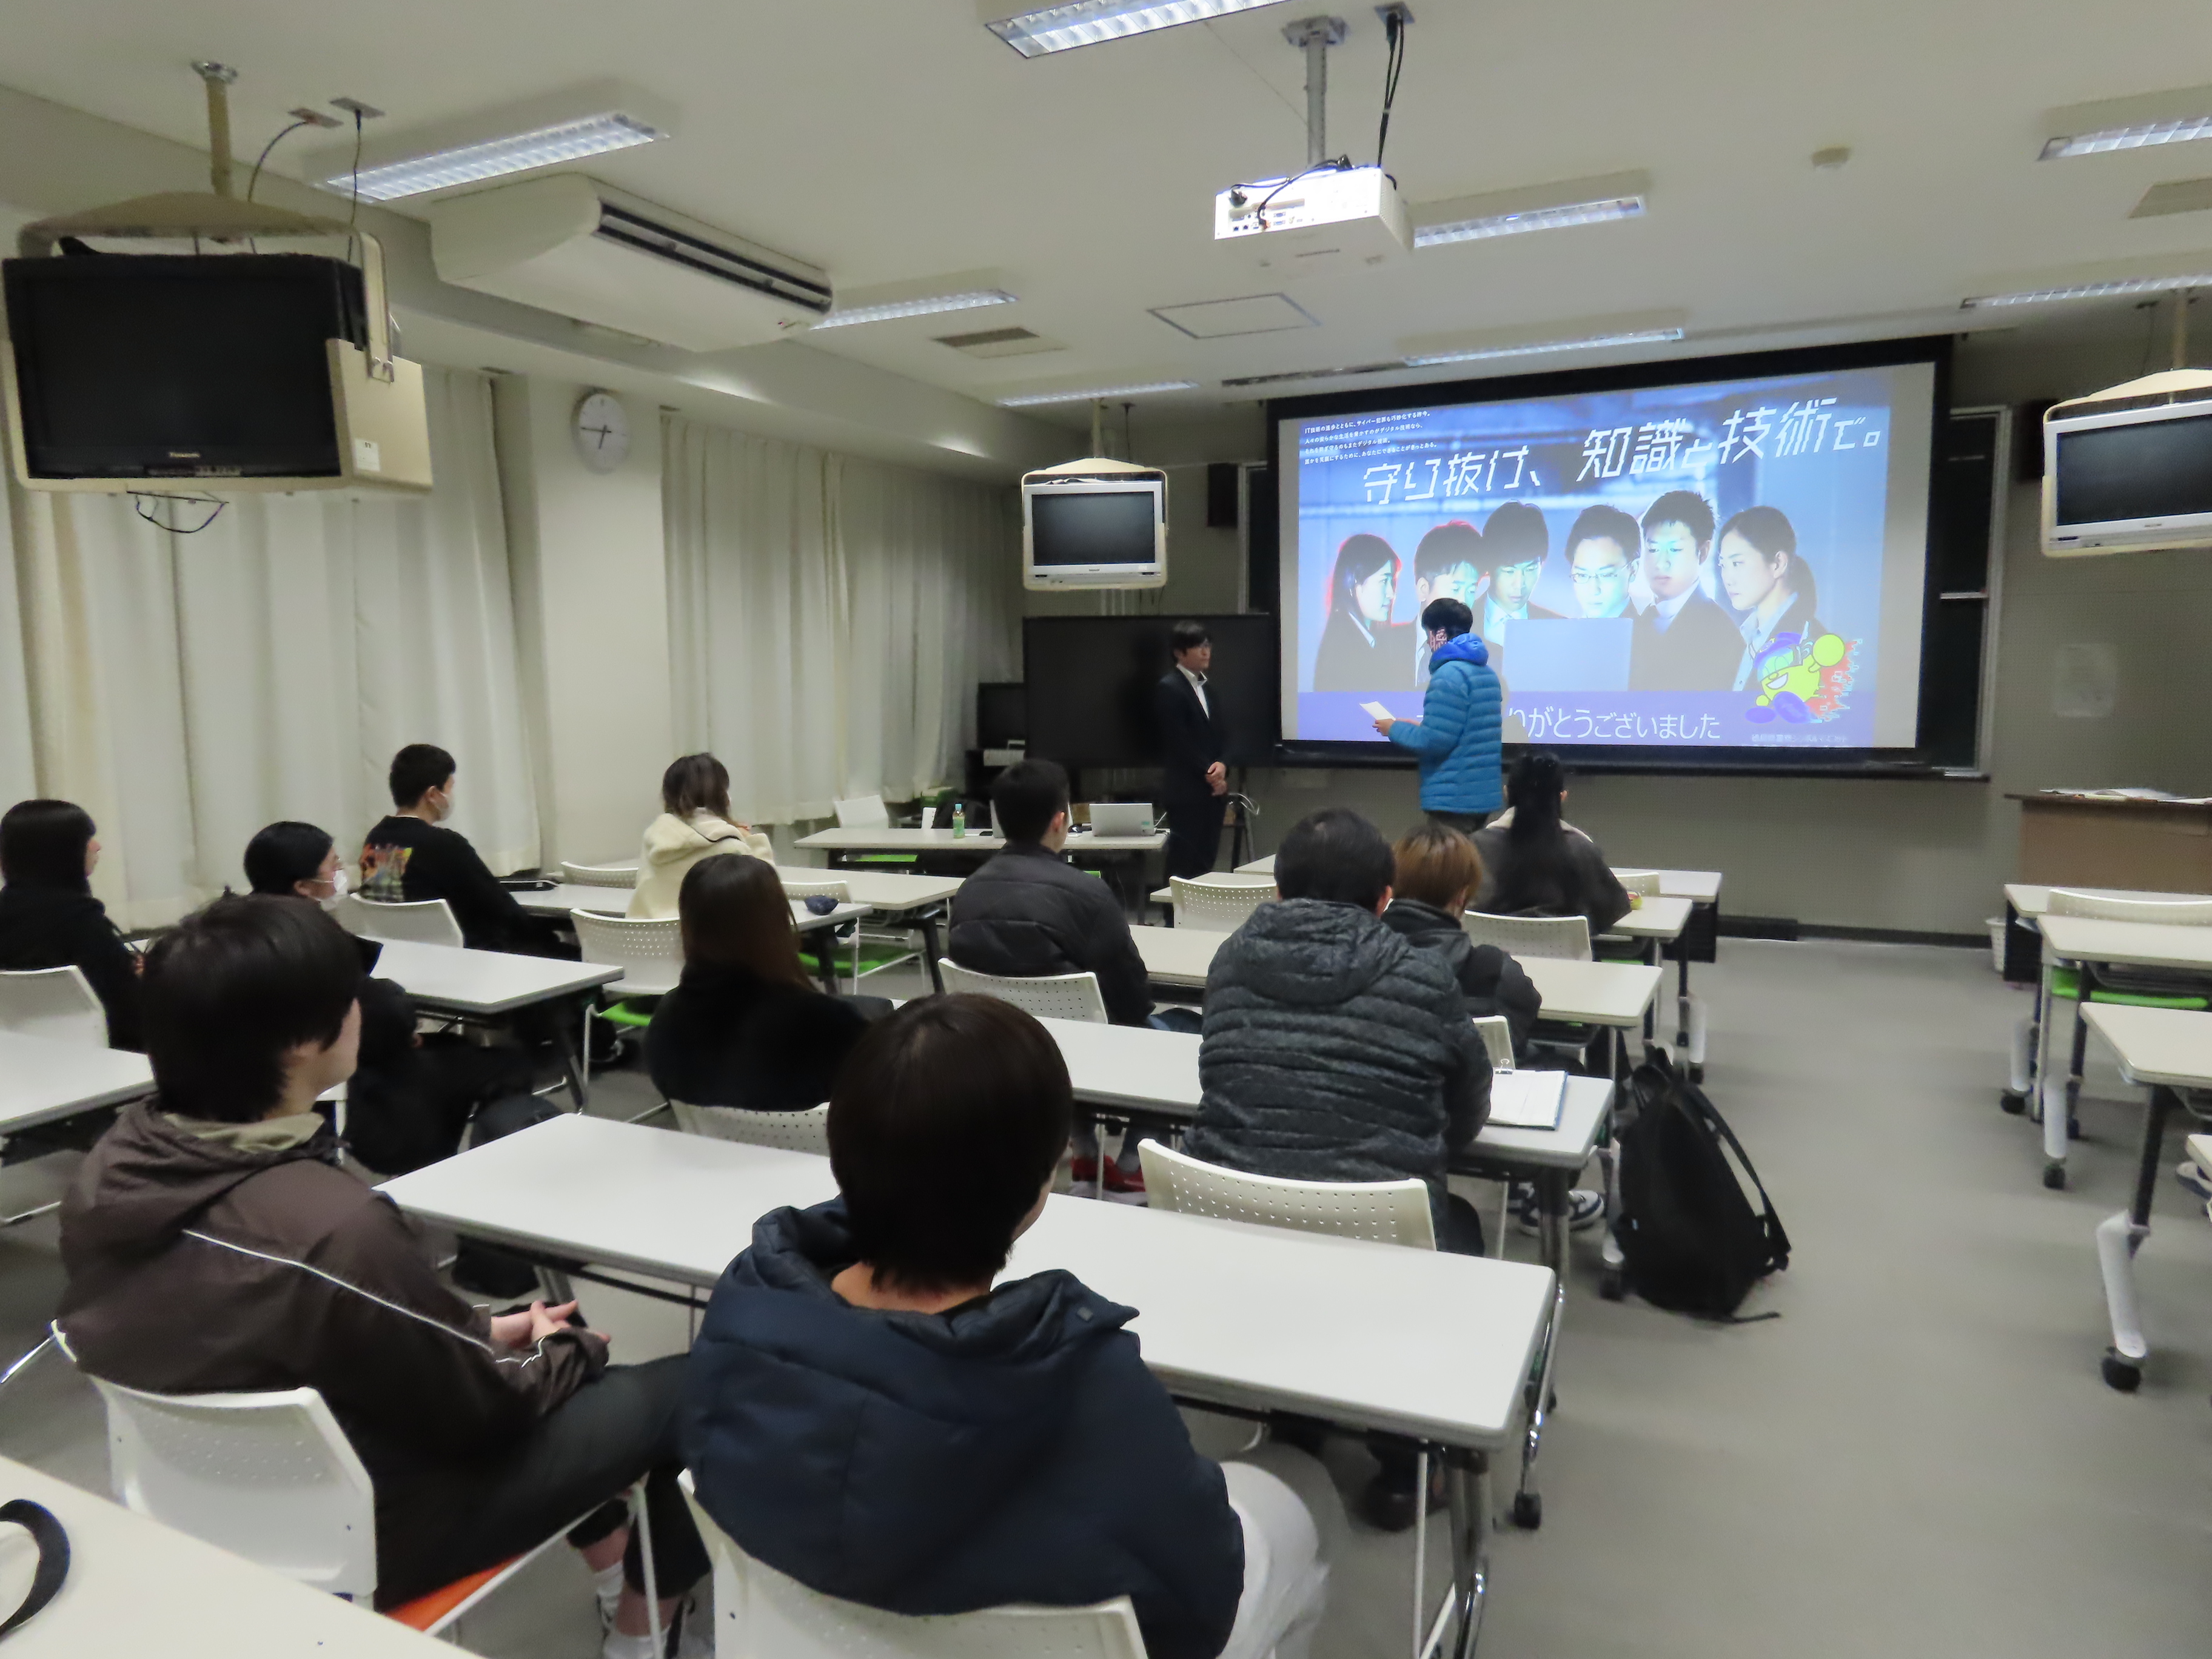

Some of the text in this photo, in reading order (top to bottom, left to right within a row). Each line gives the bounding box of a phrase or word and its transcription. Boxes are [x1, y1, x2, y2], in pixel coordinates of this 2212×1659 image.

[1363, 397, 1880, 504] 守り抜け、 知識と技術で。
